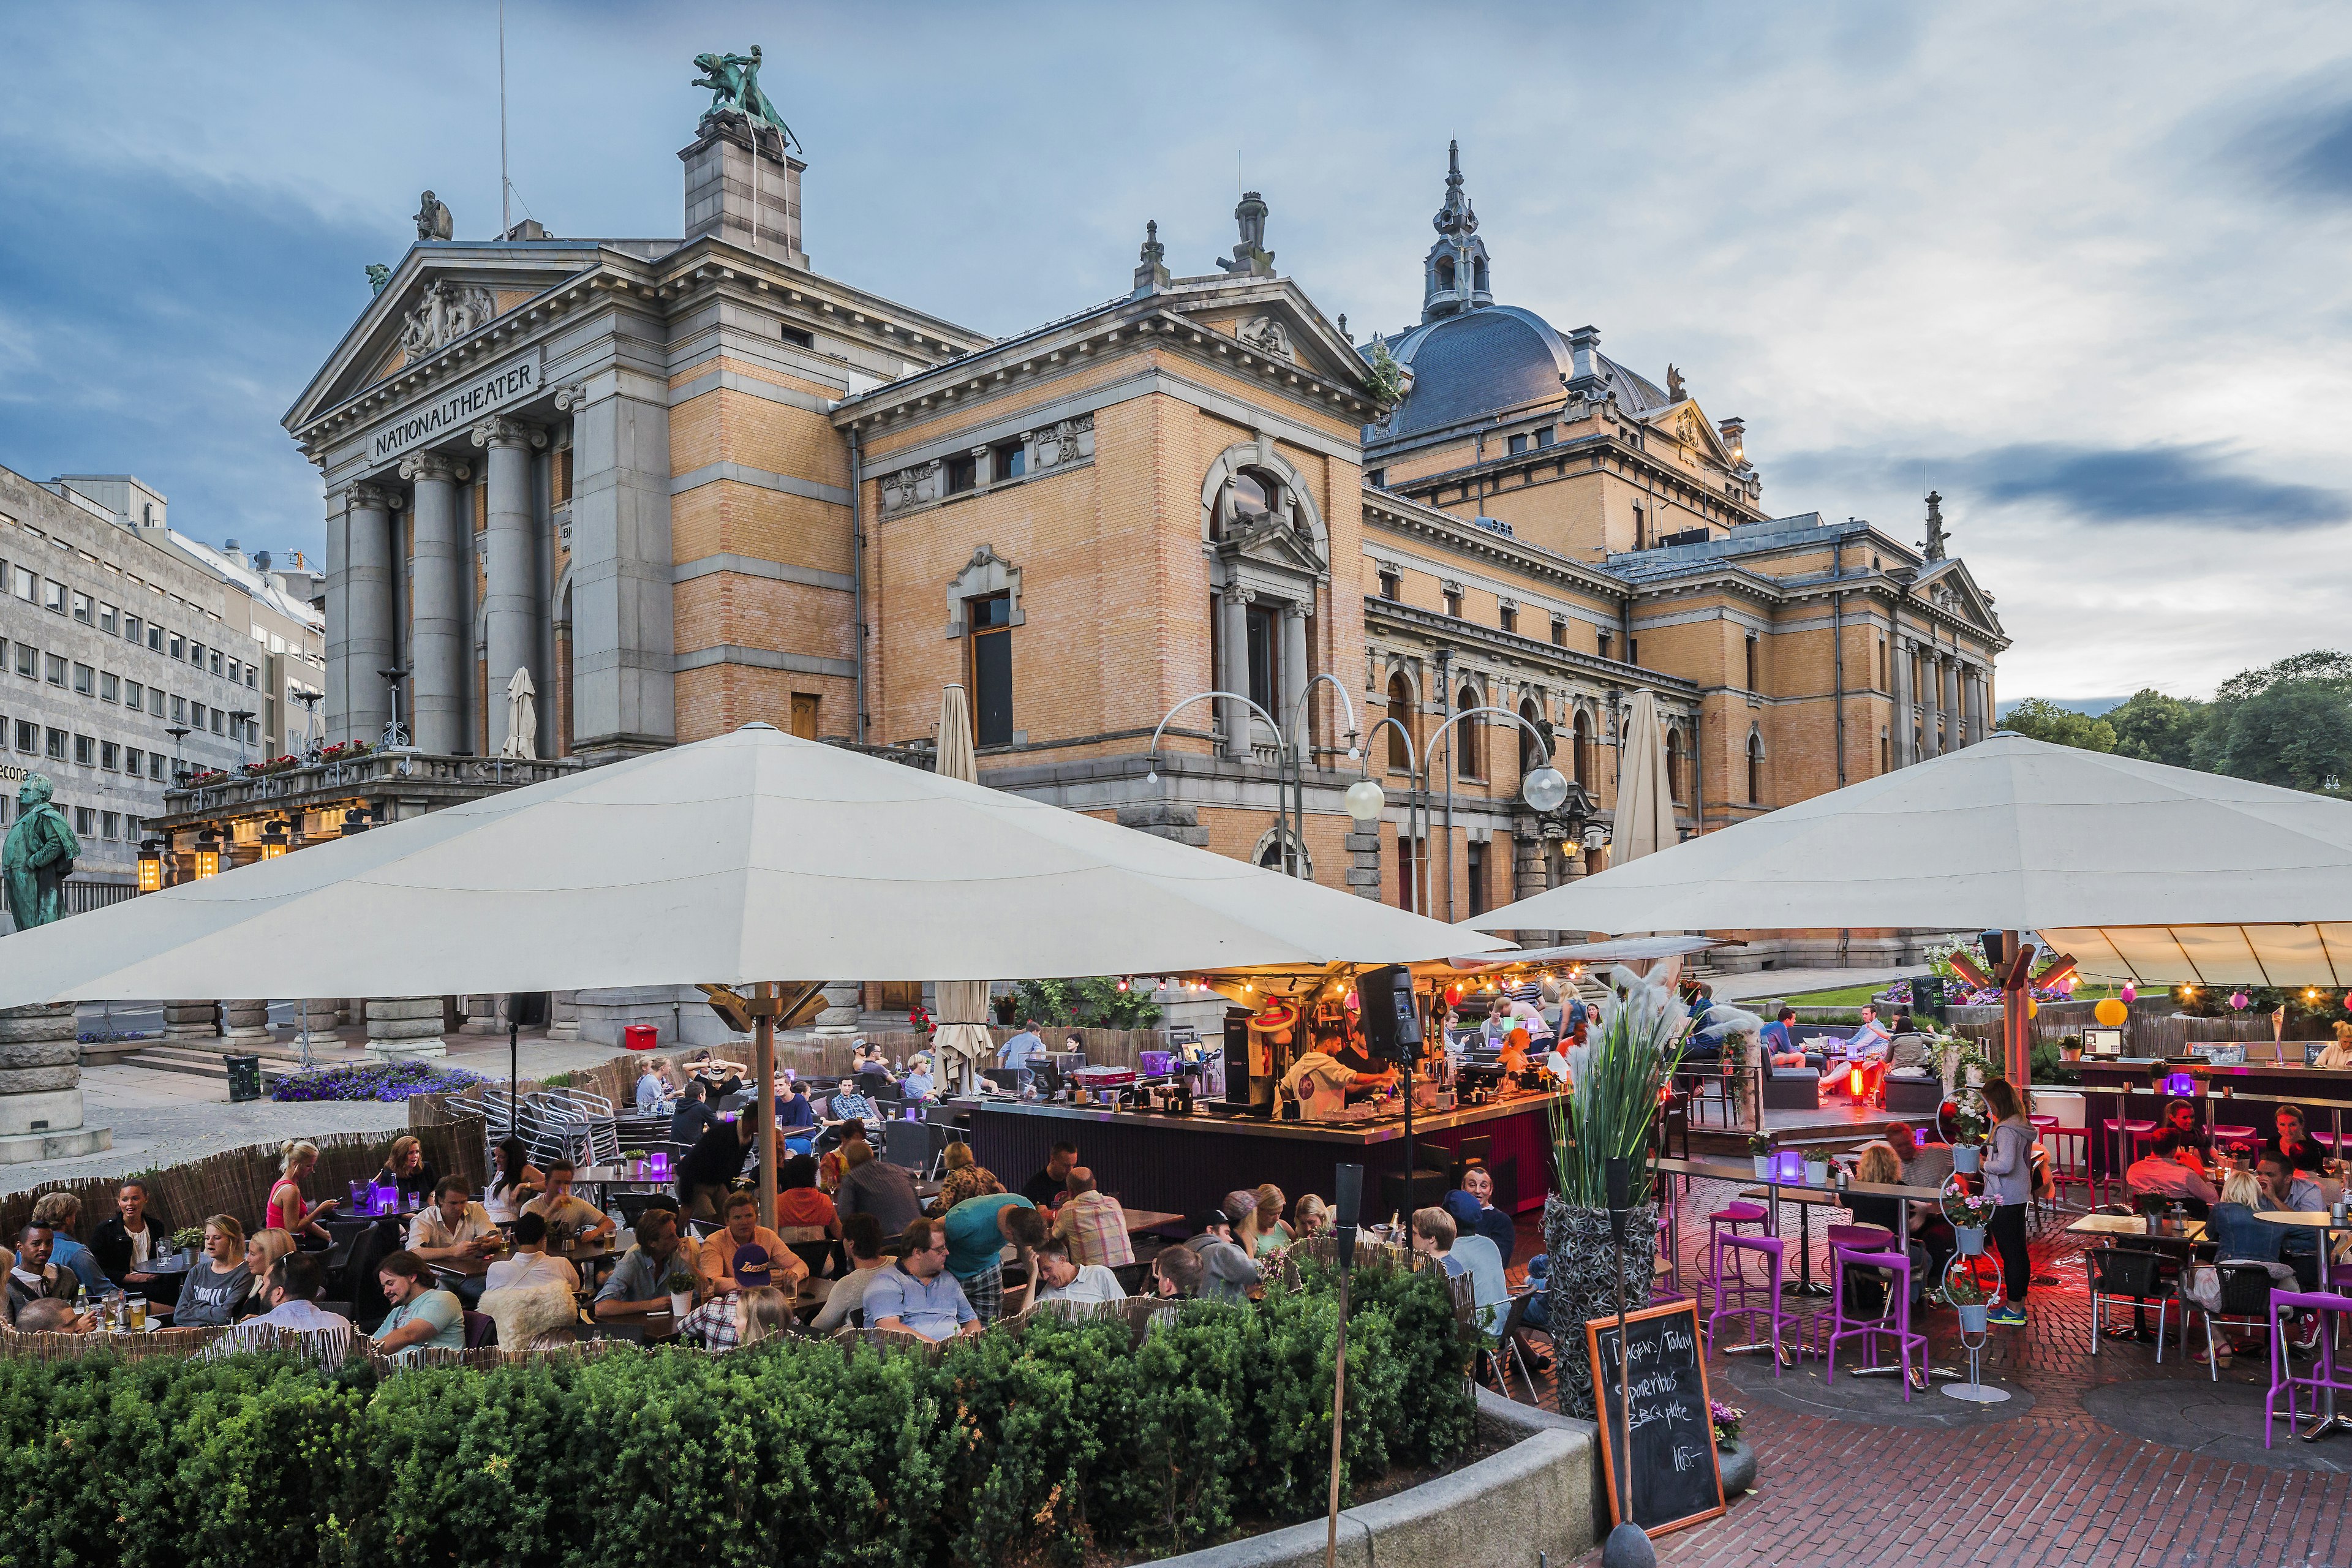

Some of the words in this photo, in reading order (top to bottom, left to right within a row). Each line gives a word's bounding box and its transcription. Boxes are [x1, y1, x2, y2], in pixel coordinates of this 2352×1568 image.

[376, 364, 531, 456] NATIONALTHEATER
[194, 1285, 232, 1306] SMIL
[1629, 1404, 1664, 1433] BBQ
[1665, 1399, 1692, 1430] plate
